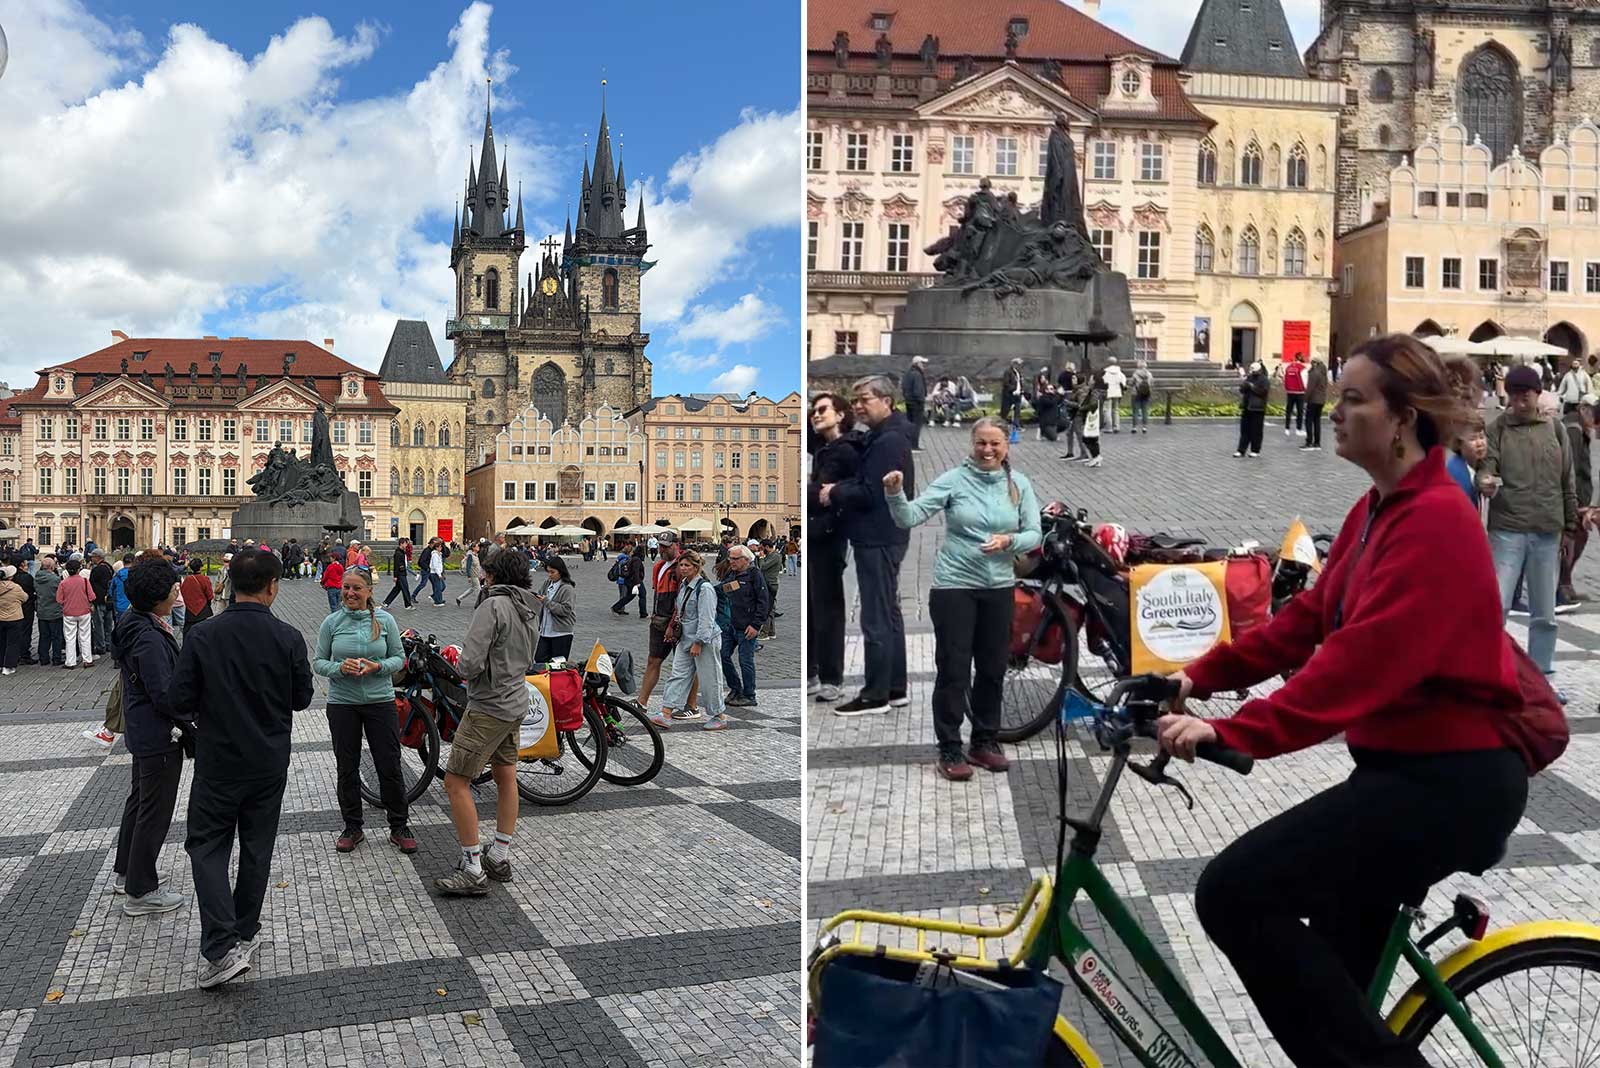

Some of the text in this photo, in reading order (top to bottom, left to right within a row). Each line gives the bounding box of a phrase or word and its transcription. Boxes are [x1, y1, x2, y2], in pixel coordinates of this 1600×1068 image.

[1143, 588, 1213, 607] South Italy
[1142, 604, 1213, 620] Greenways
[1148, 1033, 1192, 1068] STAD
